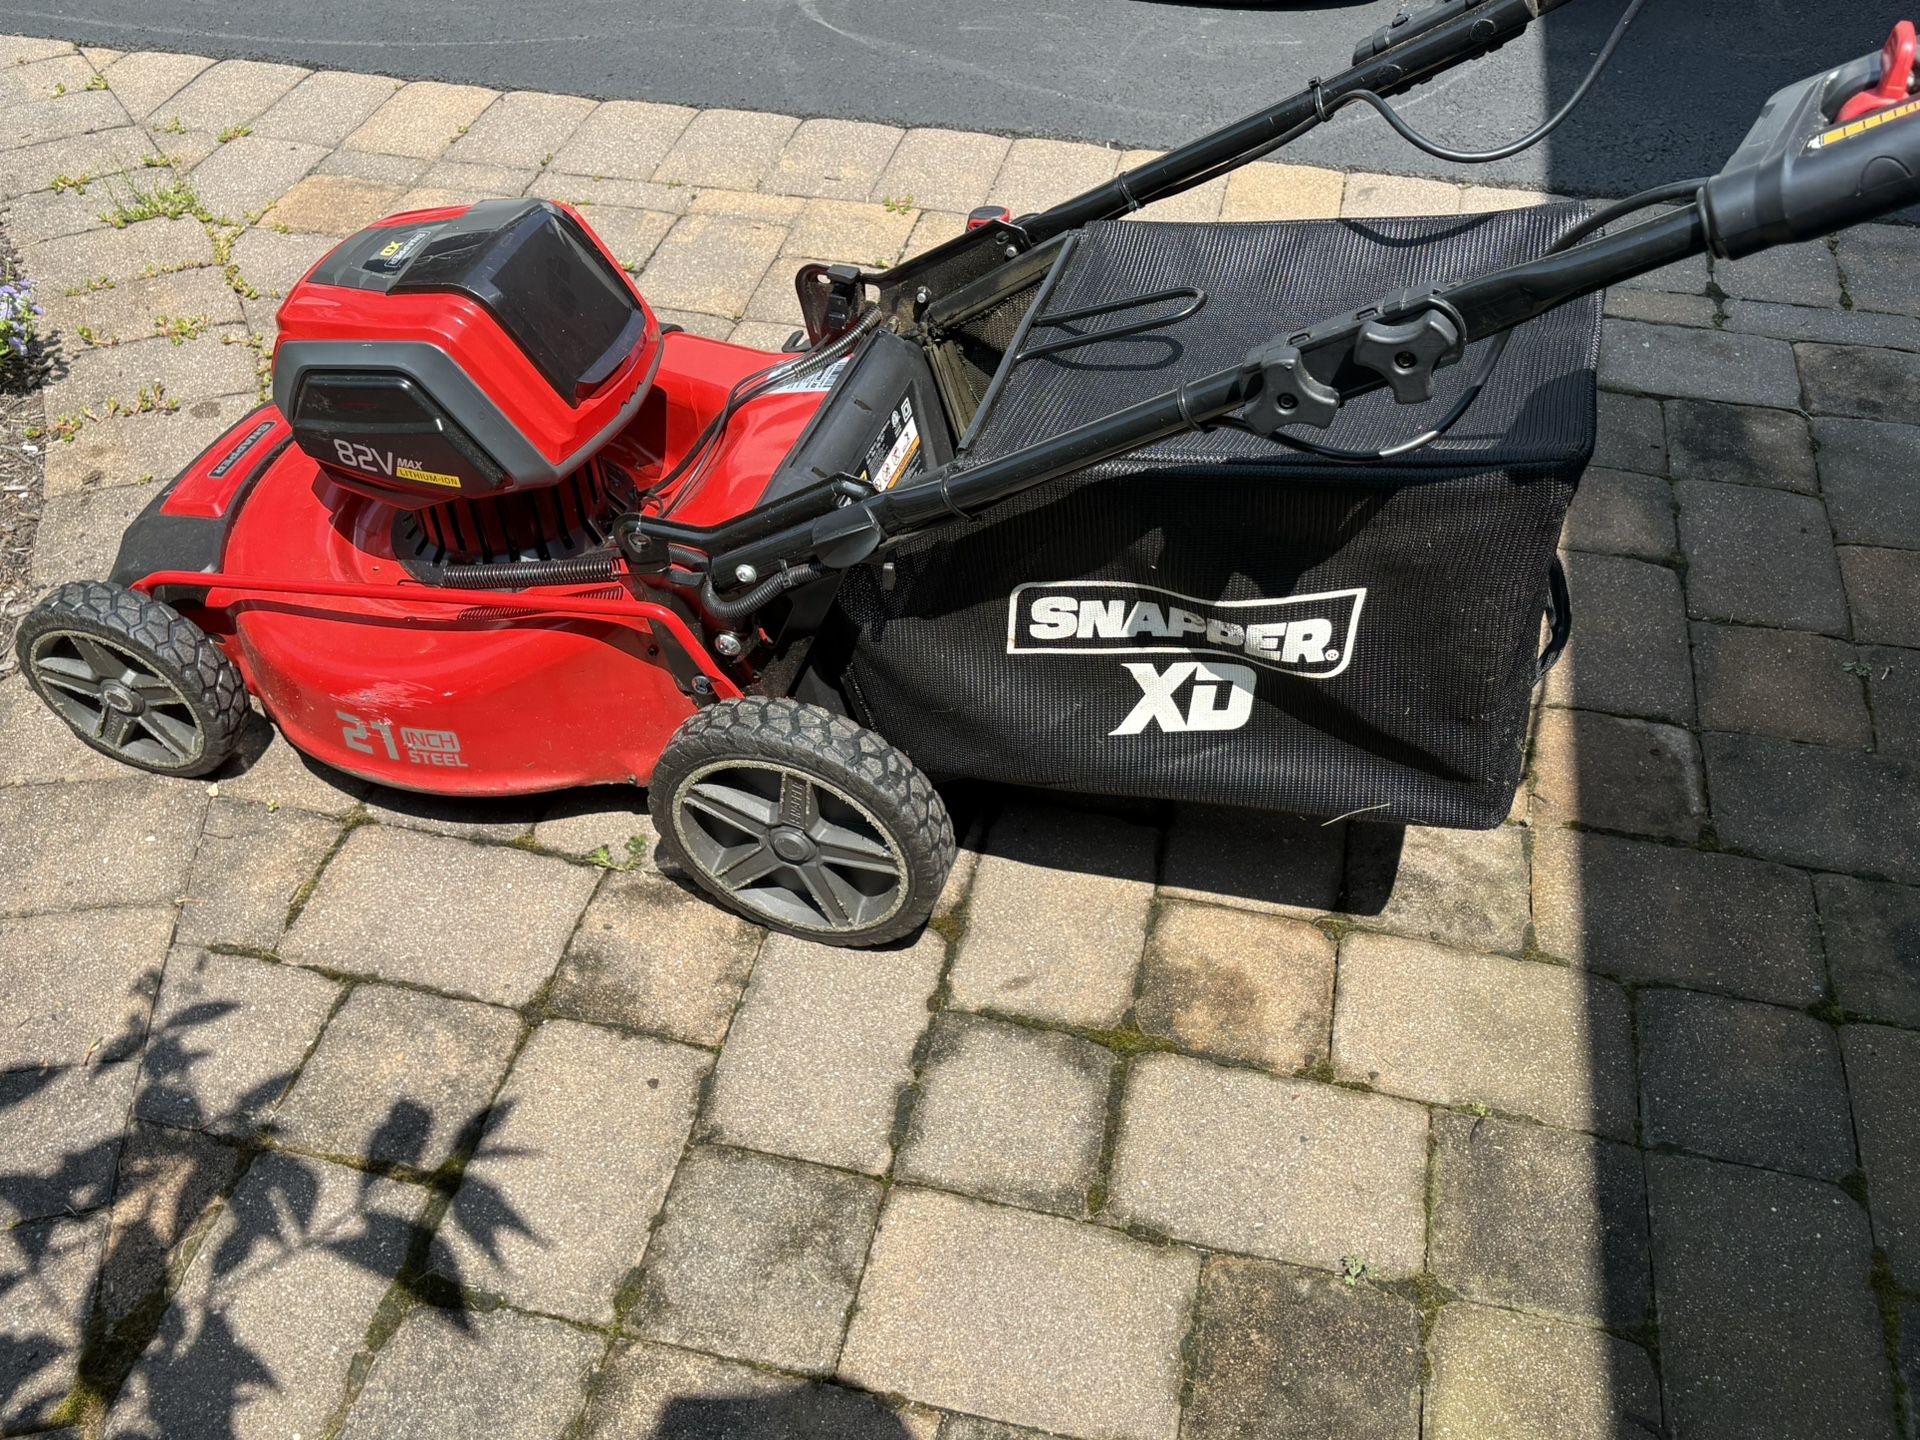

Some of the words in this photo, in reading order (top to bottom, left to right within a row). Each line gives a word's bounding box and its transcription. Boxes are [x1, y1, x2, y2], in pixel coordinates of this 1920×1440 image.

[213, 423, 271, 474] SNAPPER
[333, 438, 393, 476] 82V
[397, 457, 423, 470] MAX
[399, 468, 458, 486] LITHIUM-ION
[1108, 661, 1257, 736] XD
[335, 710, 400, 760] 21
[405, 731, 456, 749] INCH
[408, 750, 469, 767] STEEL
